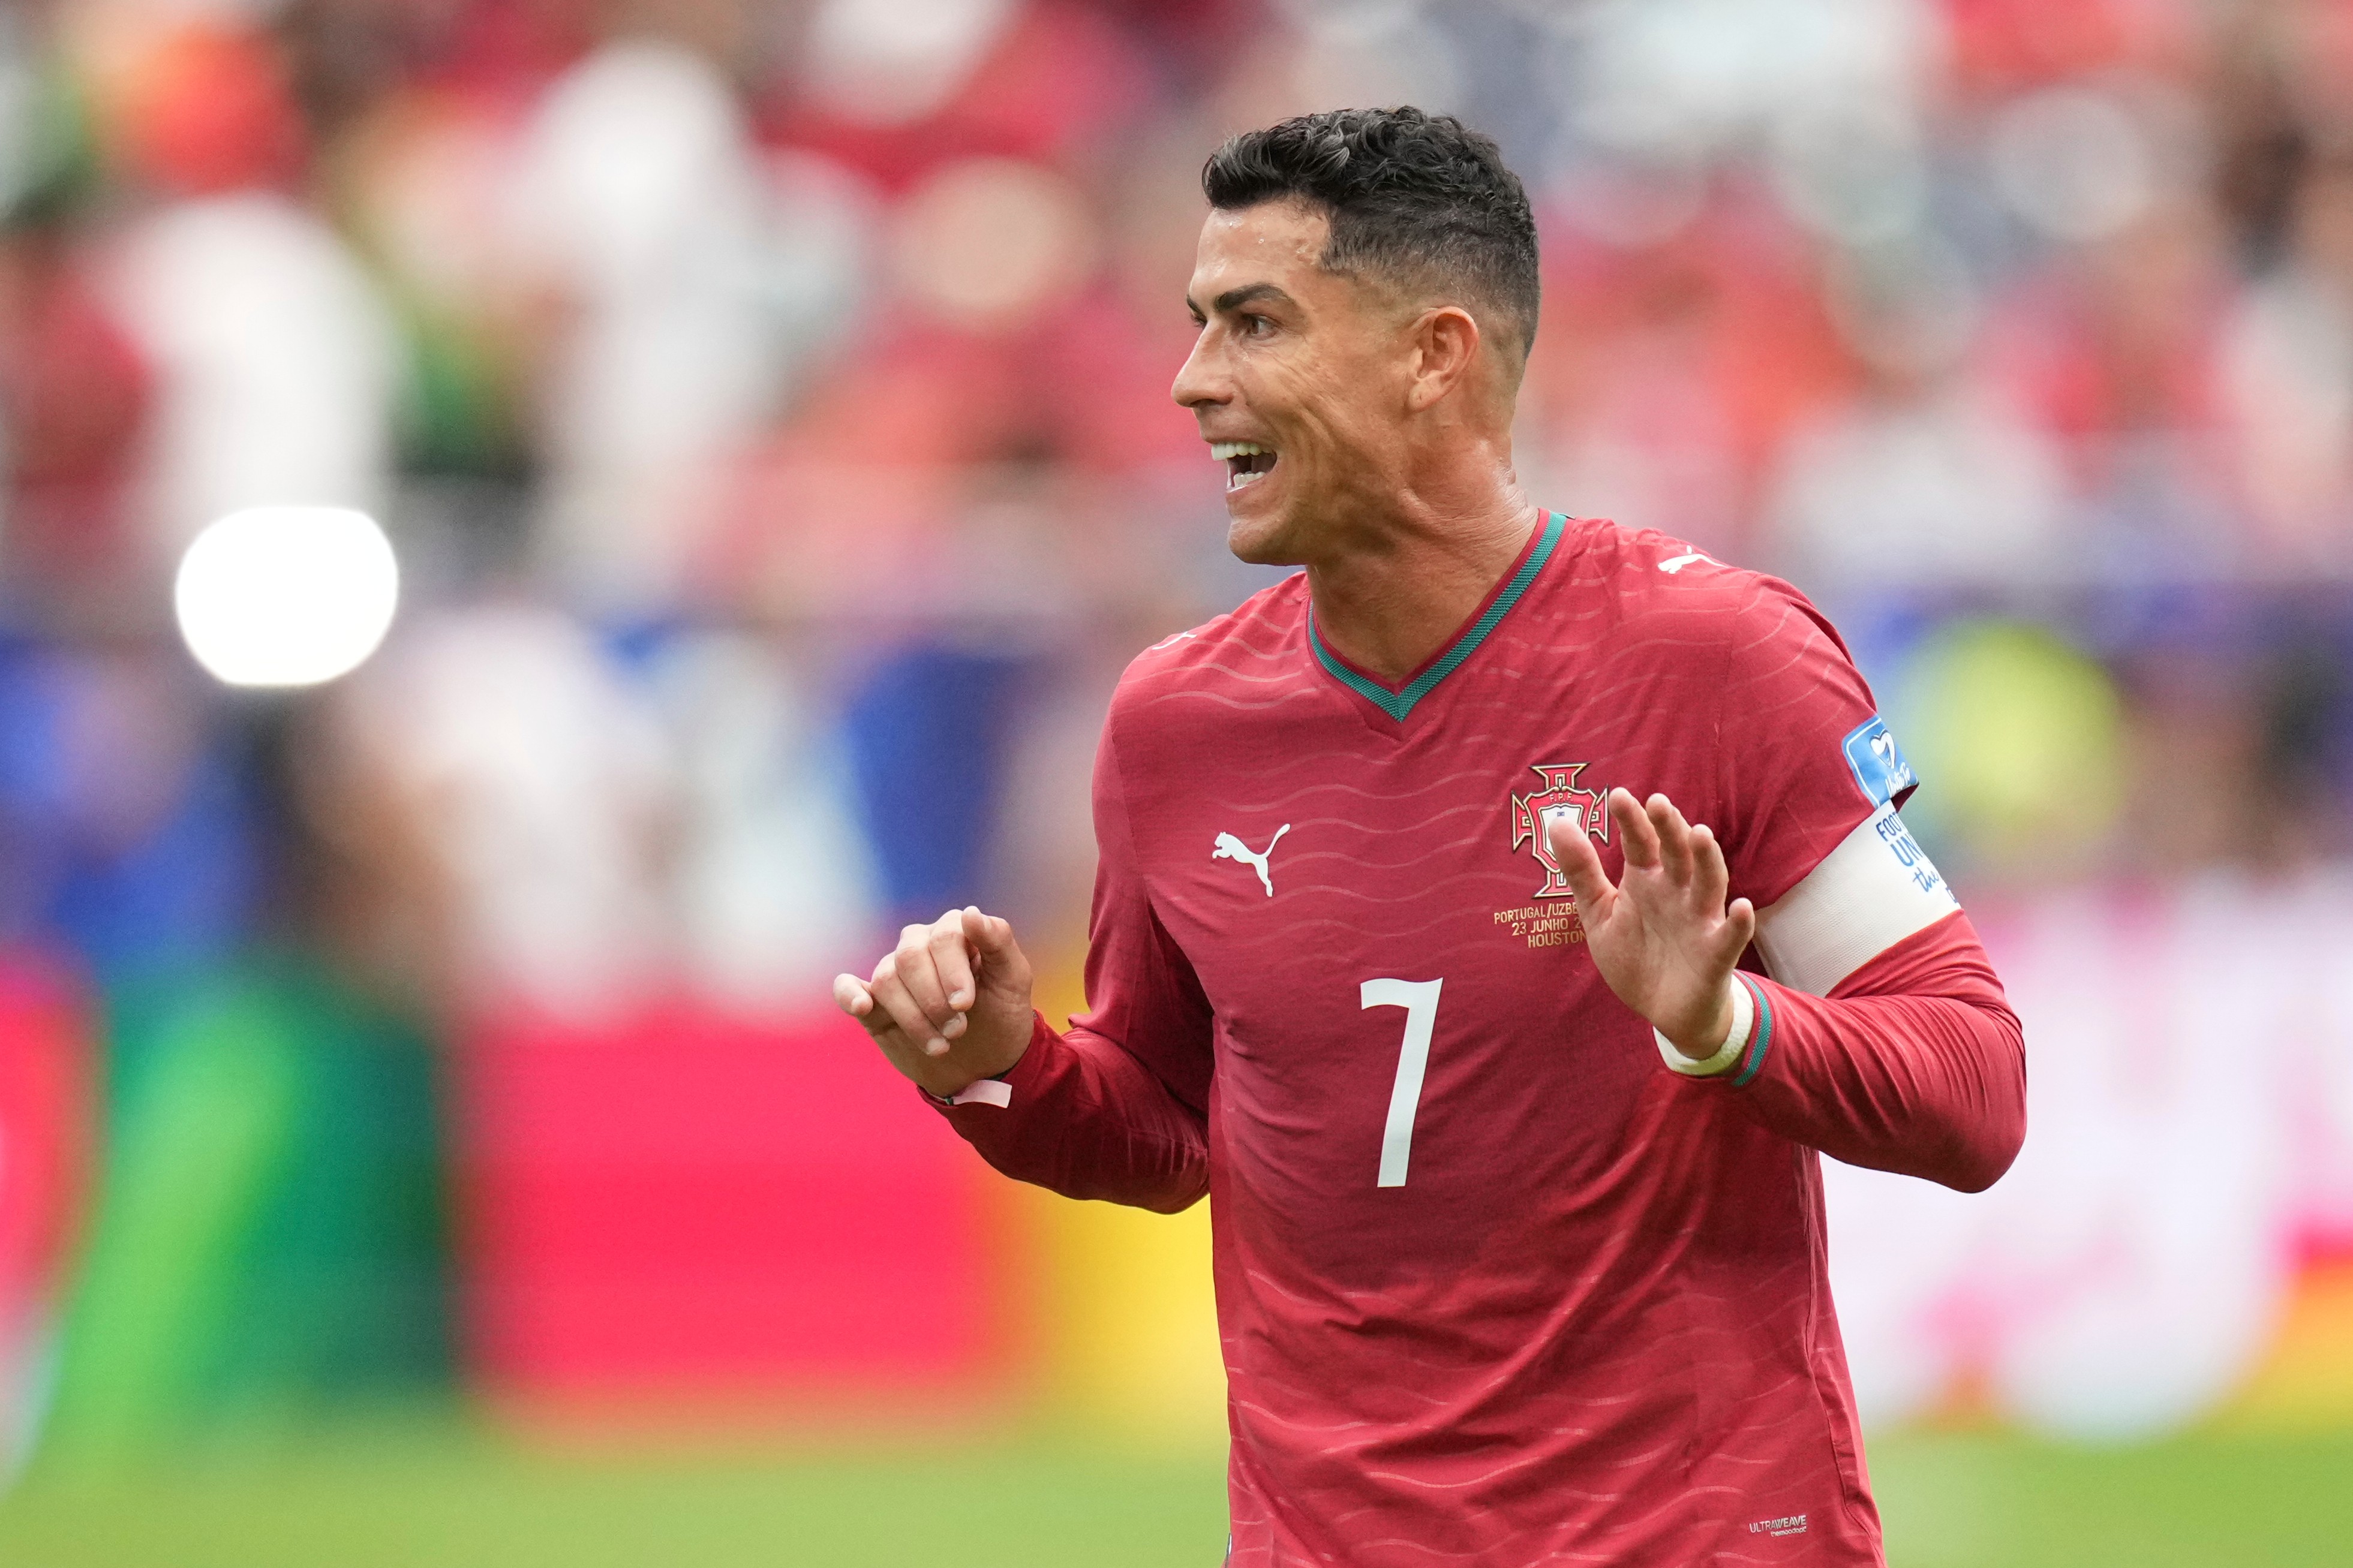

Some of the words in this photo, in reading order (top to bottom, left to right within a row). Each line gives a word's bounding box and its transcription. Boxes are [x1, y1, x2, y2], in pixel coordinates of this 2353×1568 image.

[1549, 793, 1573, 803] F.P.F.
[1913, 866, 1940, 892] the
[1511, 922, 1527, 936] 23
[1531, 917, 1568, 934] JUNHO
[1360, 977, 1444, 1188] 7
[1749, 1515, 1807, 1533] ULTRAWEAVE
